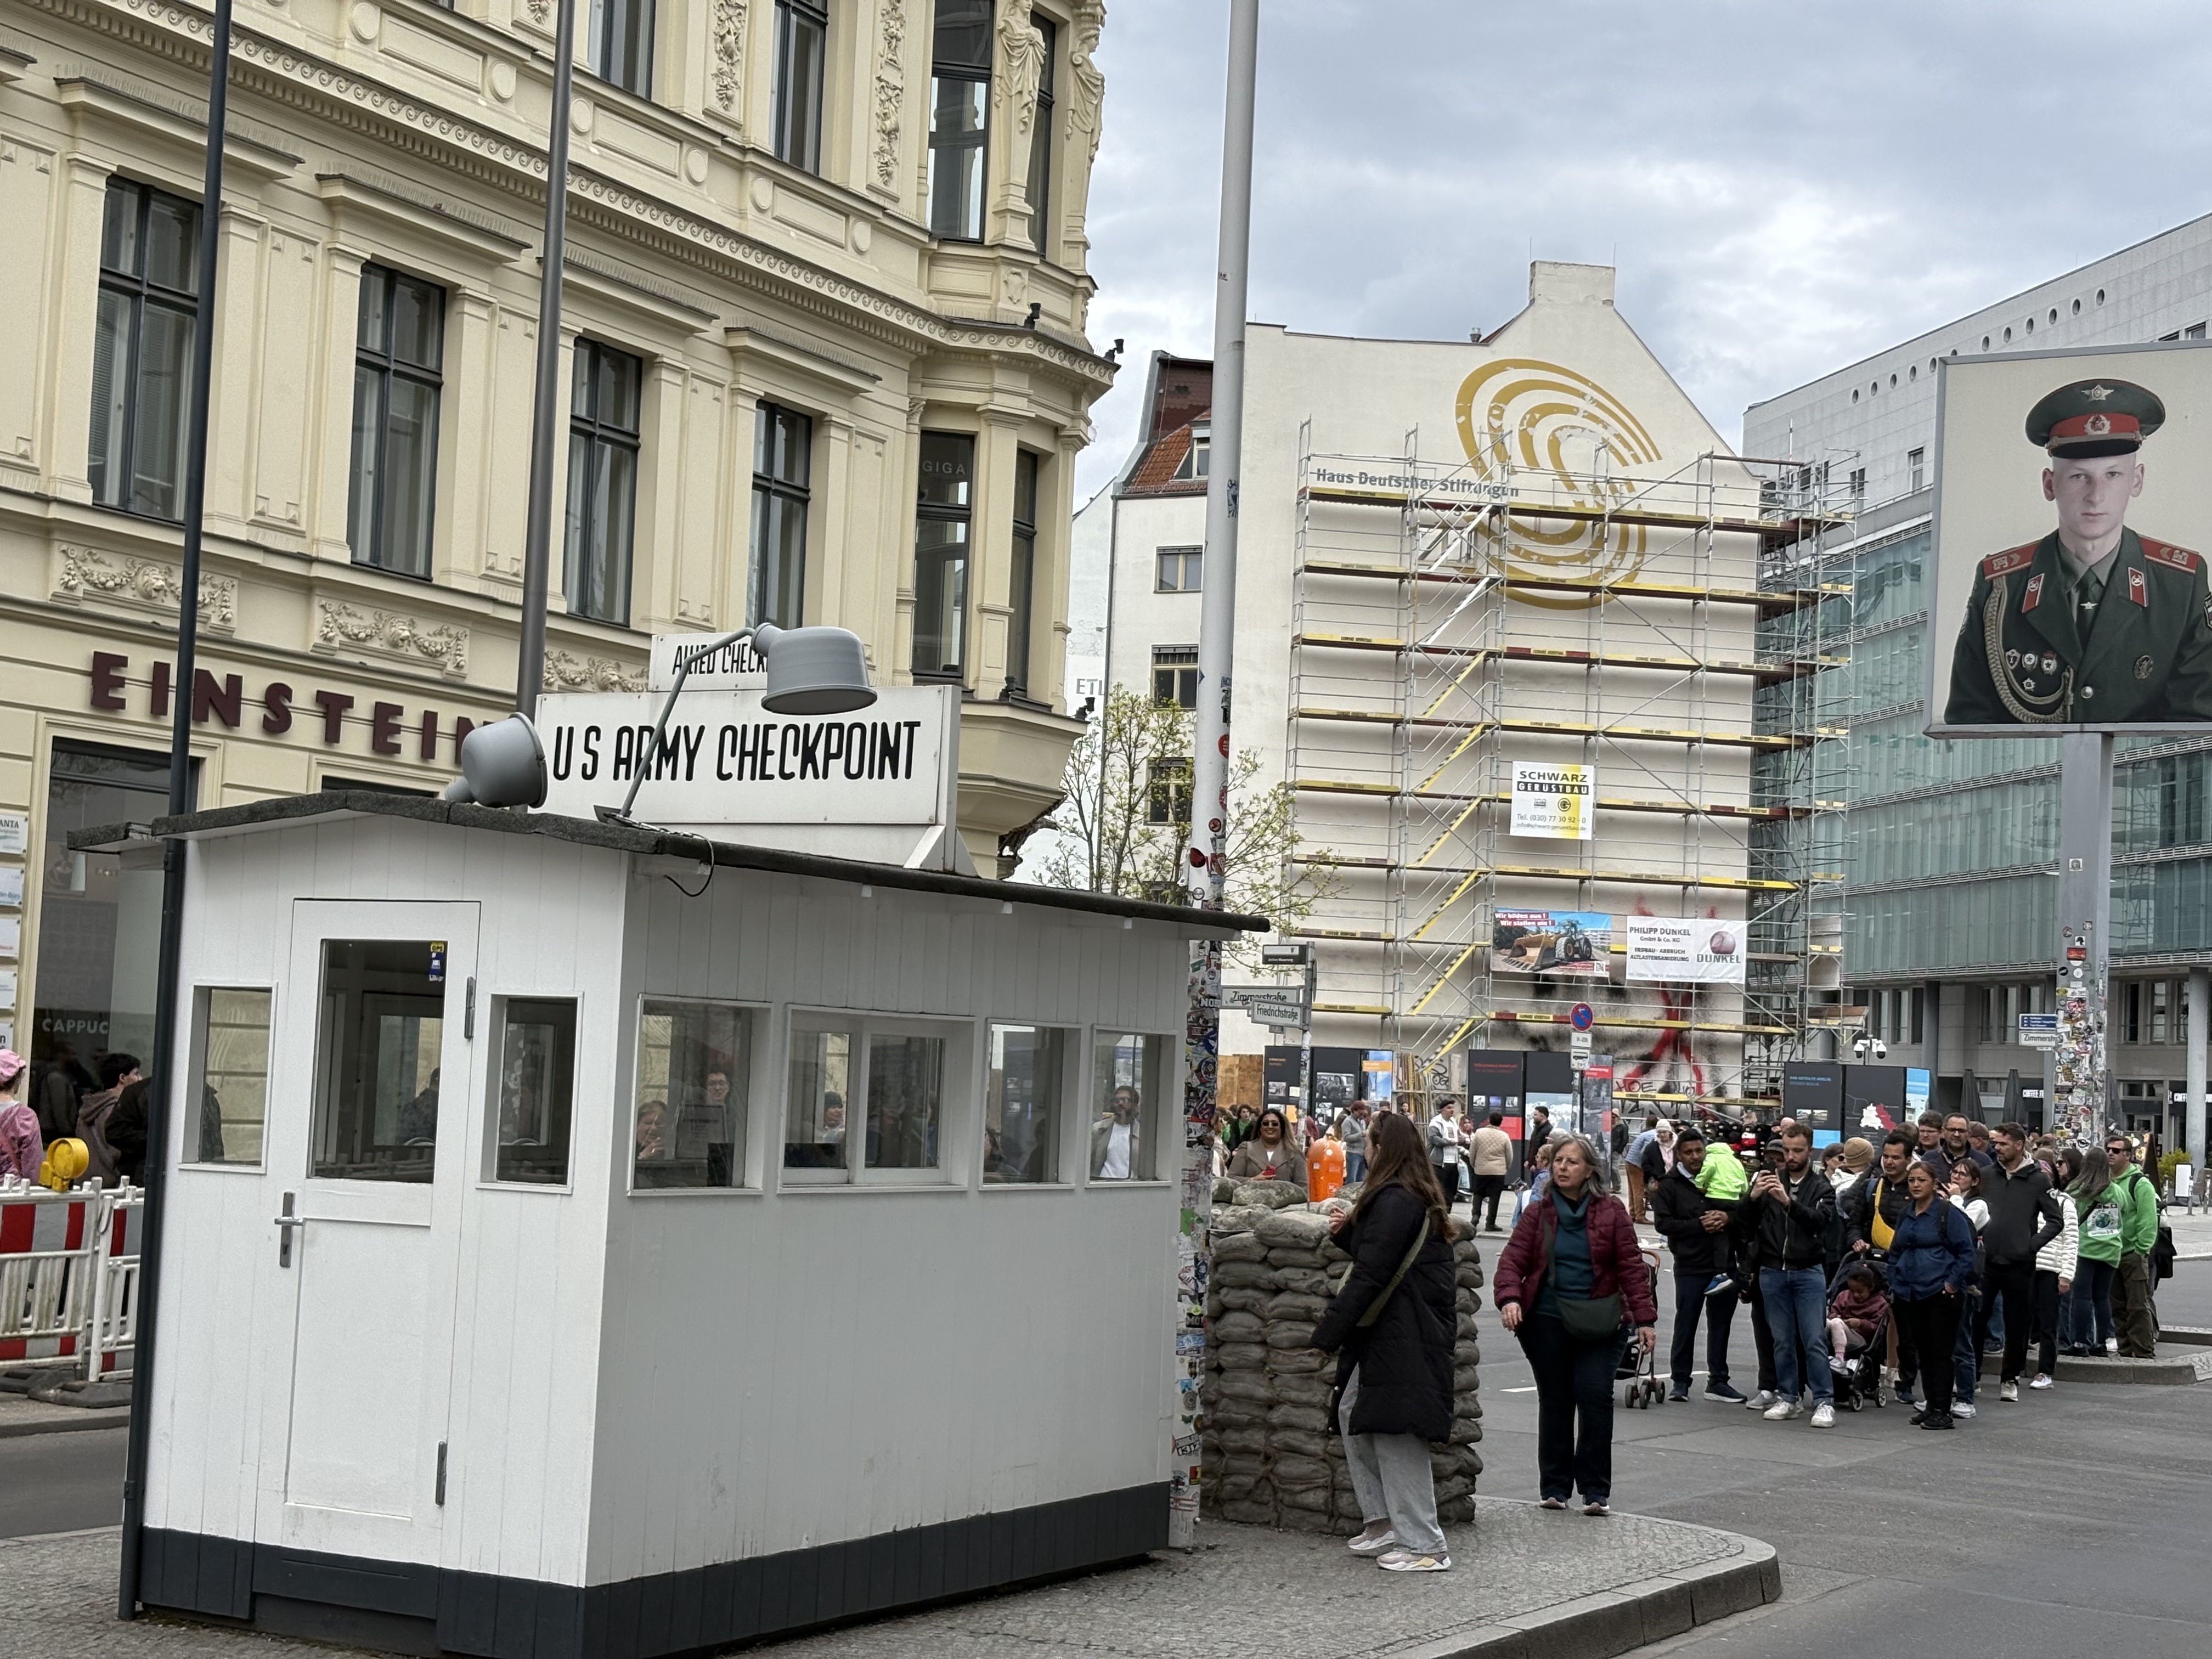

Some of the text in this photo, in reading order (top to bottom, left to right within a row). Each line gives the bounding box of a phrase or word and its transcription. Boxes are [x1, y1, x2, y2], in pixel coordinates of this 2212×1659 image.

[922, 460, 965, 475] GIGA
[1317, 468, 1354, 483] Haus
[721, 643, 768, 674] CHECK
[554, 721, 921, 781] U S ARMY CHECKPOINT
[1519, 771, 1587, 782] SCHWARZ
[1660, 928, 1691, 936] DUNKEL
[1696, 953, 1741, 964] DUNKEL
[1256, 1004, 1299, 1022] Friedrichstraße
